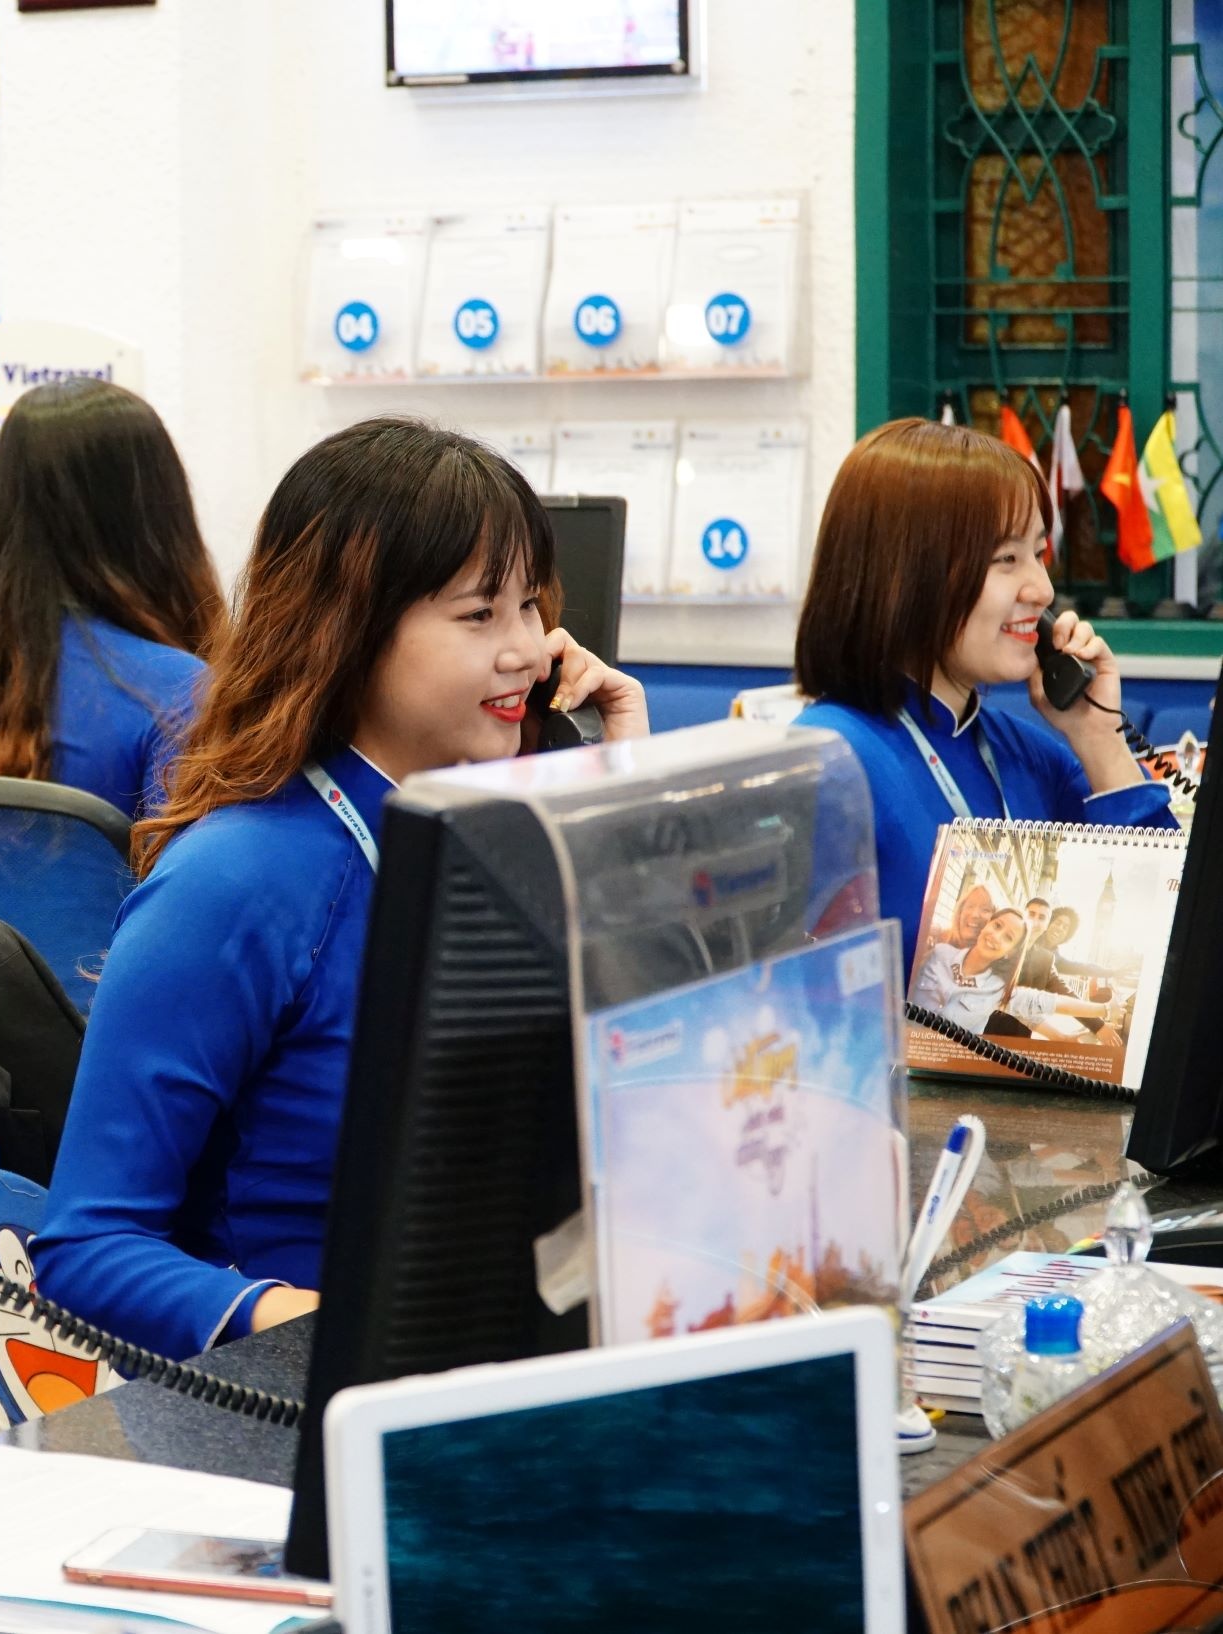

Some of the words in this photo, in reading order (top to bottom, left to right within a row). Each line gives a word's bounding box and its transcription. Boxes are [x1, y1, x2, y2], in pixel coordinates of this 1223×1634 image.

[338, 312, 376, 344] 04
[456, 307, 496, 340] 05
[577, 304, 617, 337] 06
[707, 303, 746, 336] 07
[708, 527, 744, 560] 14
[337, 799, 369, 842] Vietravel
